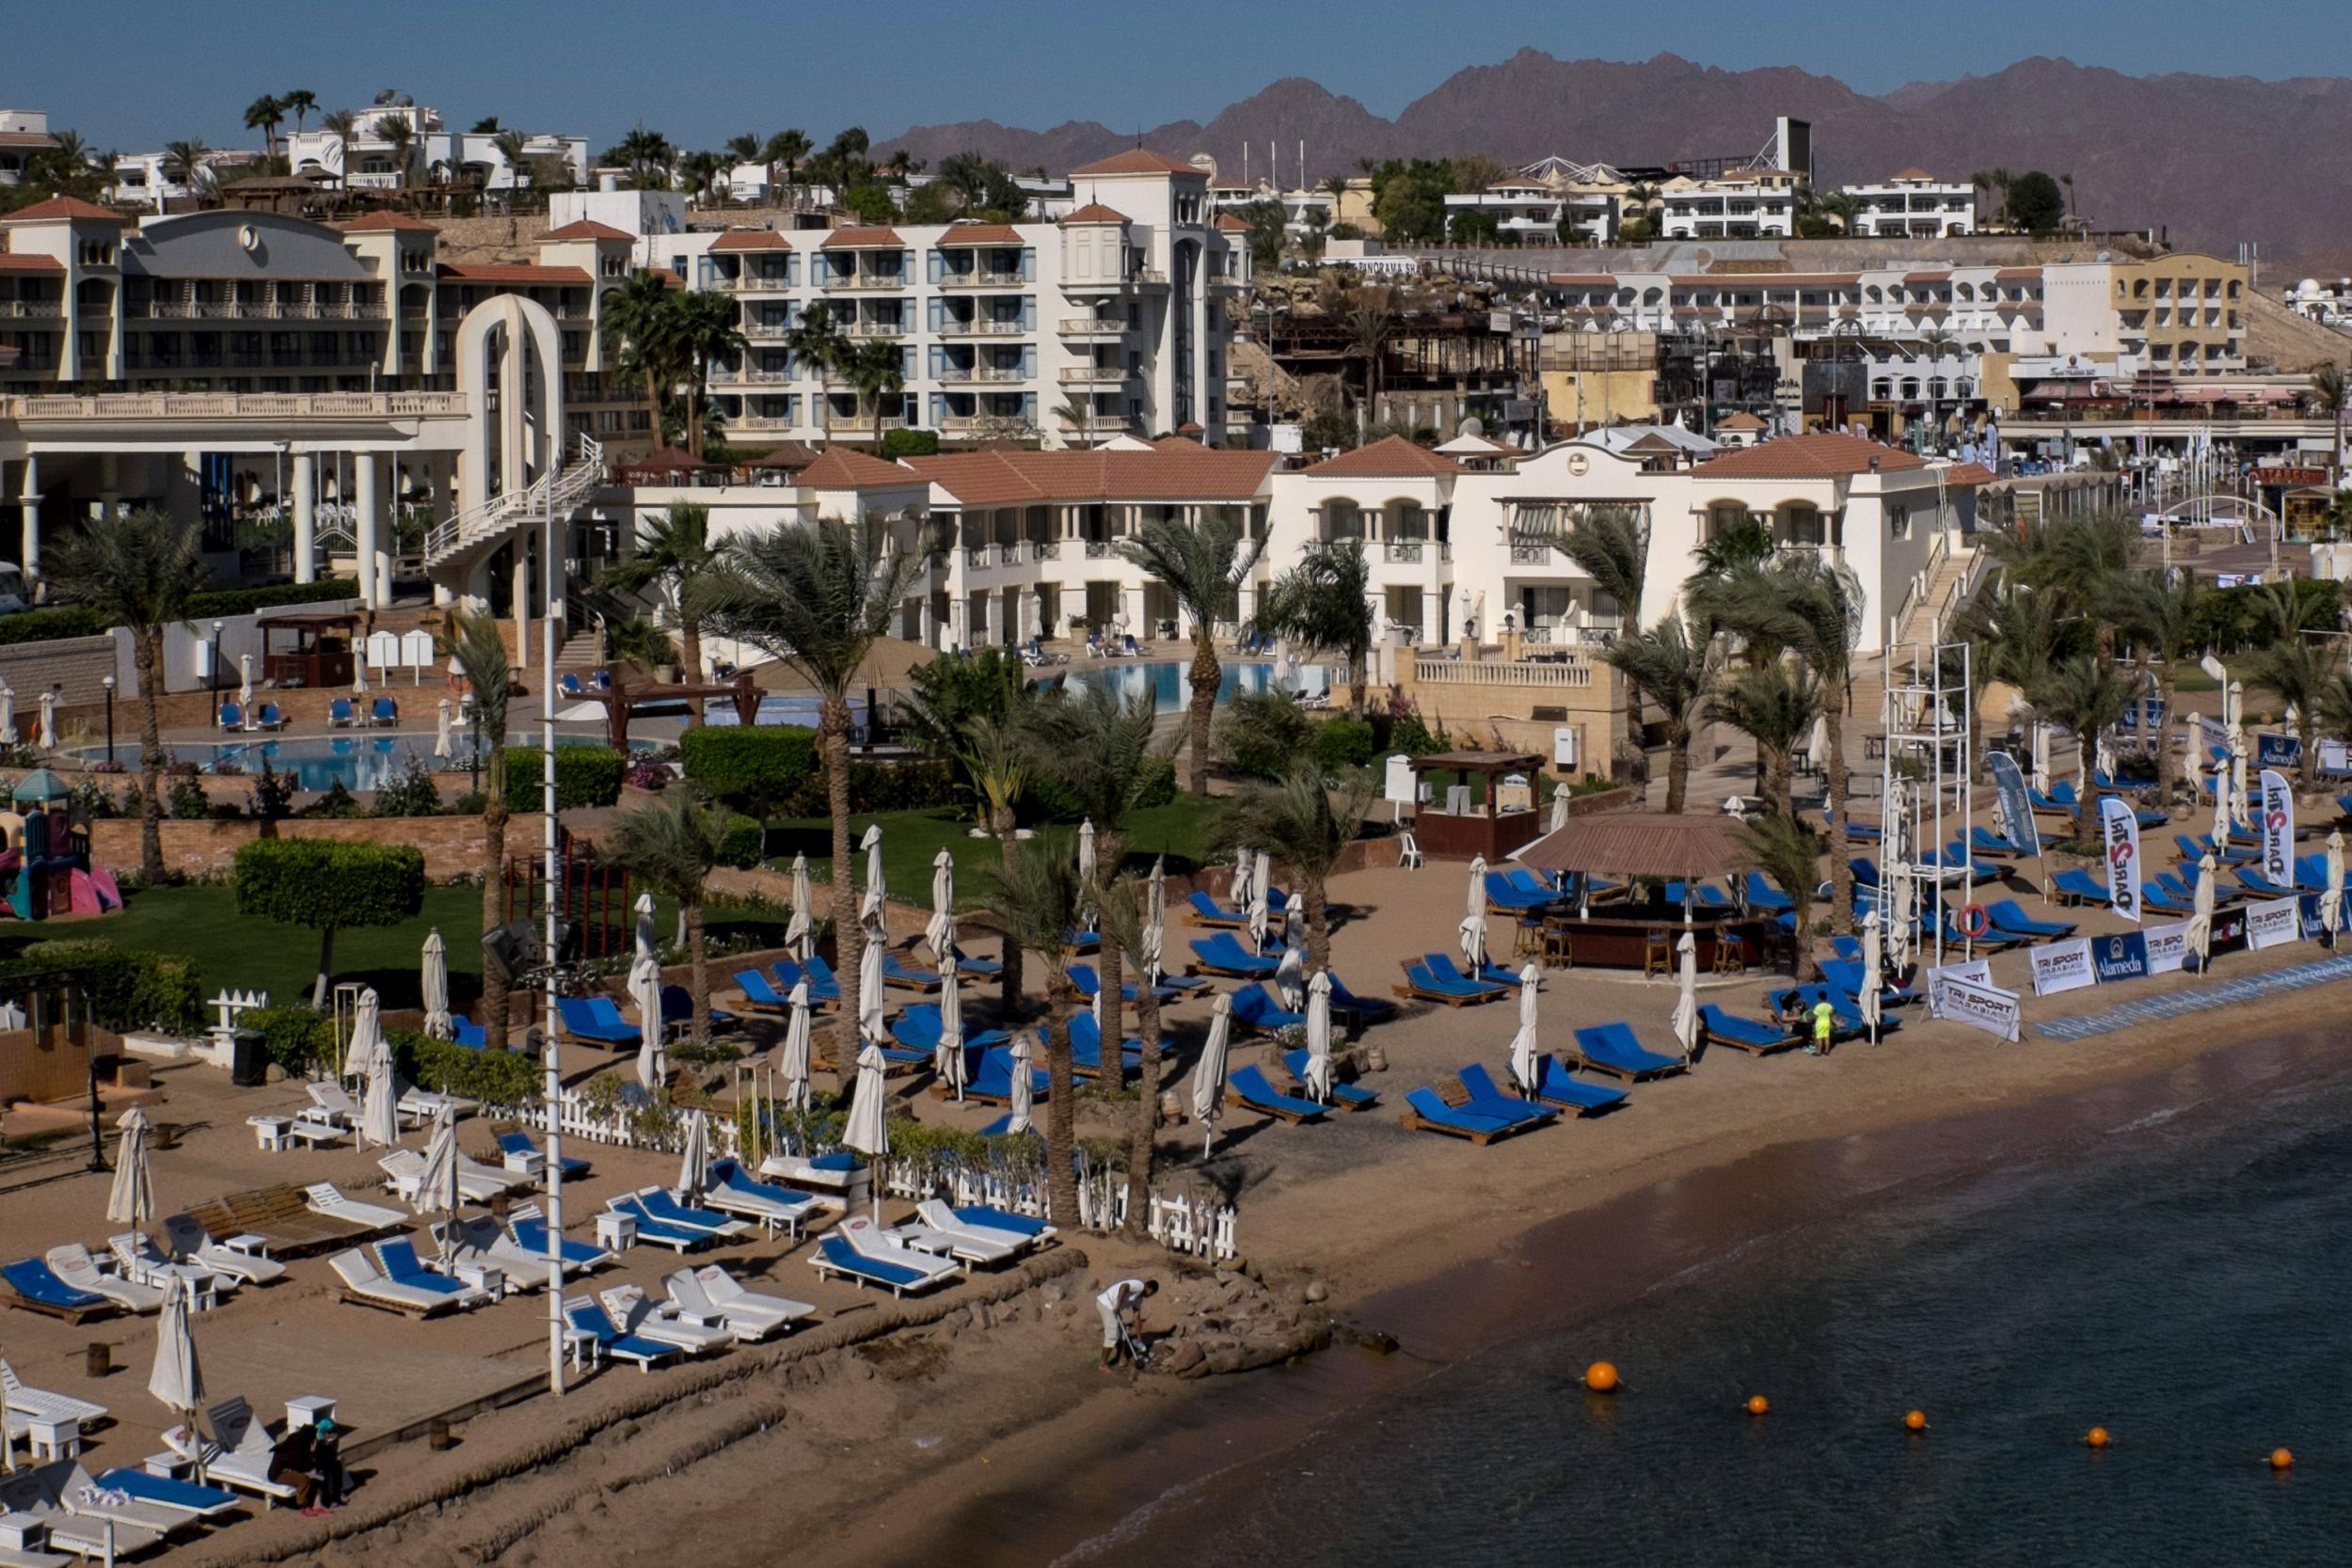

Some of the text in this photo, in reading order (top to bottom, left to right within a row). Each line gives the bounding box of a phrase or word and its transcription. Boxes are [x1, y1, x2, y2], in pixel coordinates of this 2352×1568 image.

[1359, 261, 1403, 275] PANORAMA
[1713, 261, 1787, 273] RESORT
[2265, 908, 2293, 923] SPORT
[2163, 935, 2184, 946] SPO
[2051, 951, 2085, 966] SPORT
[2099, 953, 2142, 977] Alameda
[2046, 962, 2075, 974] ARABIA
[1958, 1000, 1997, 1017] ARABIA
[1967, 993, 2012, 1014] SPORT
